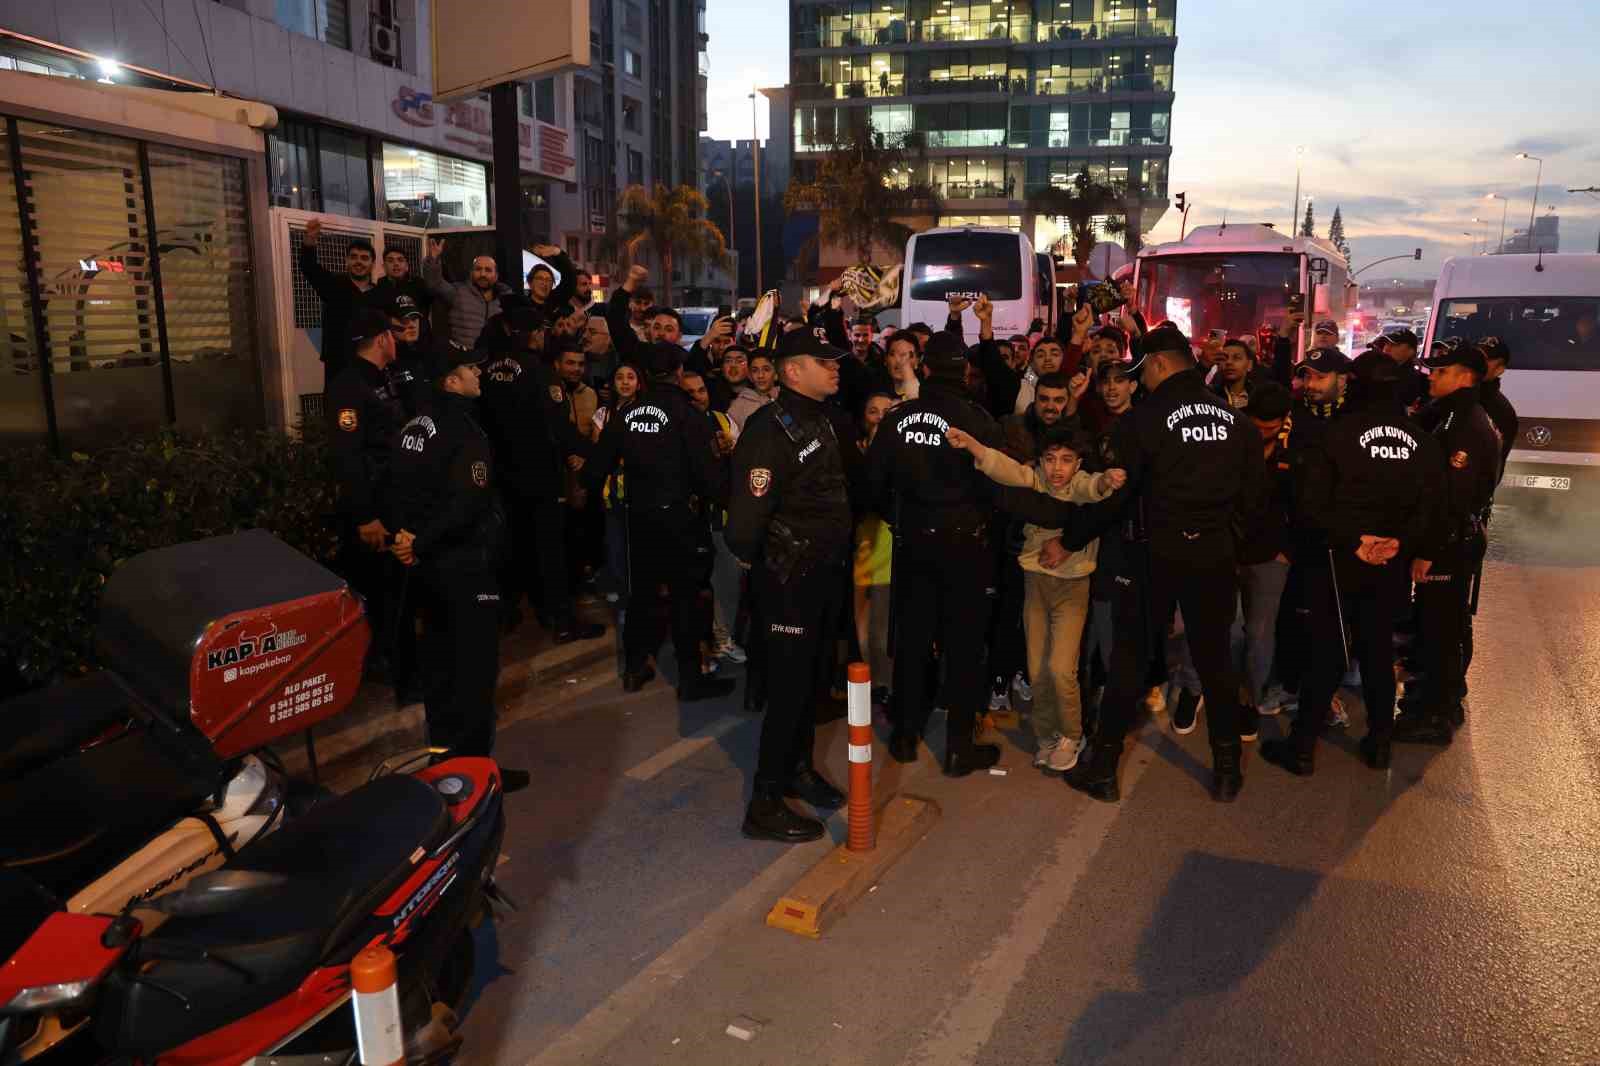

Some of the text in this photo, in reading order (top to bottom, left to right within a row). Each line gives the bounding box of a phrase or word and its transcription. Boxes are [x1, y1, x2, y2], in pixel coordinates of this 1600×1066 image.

[922, 412, 950, 433] KUVVE
[1194, 403, 1235, 425] KUVVET
[1384, 425, 1418, 452] KUVVET
[302, 673, 328, 688] PAKET
